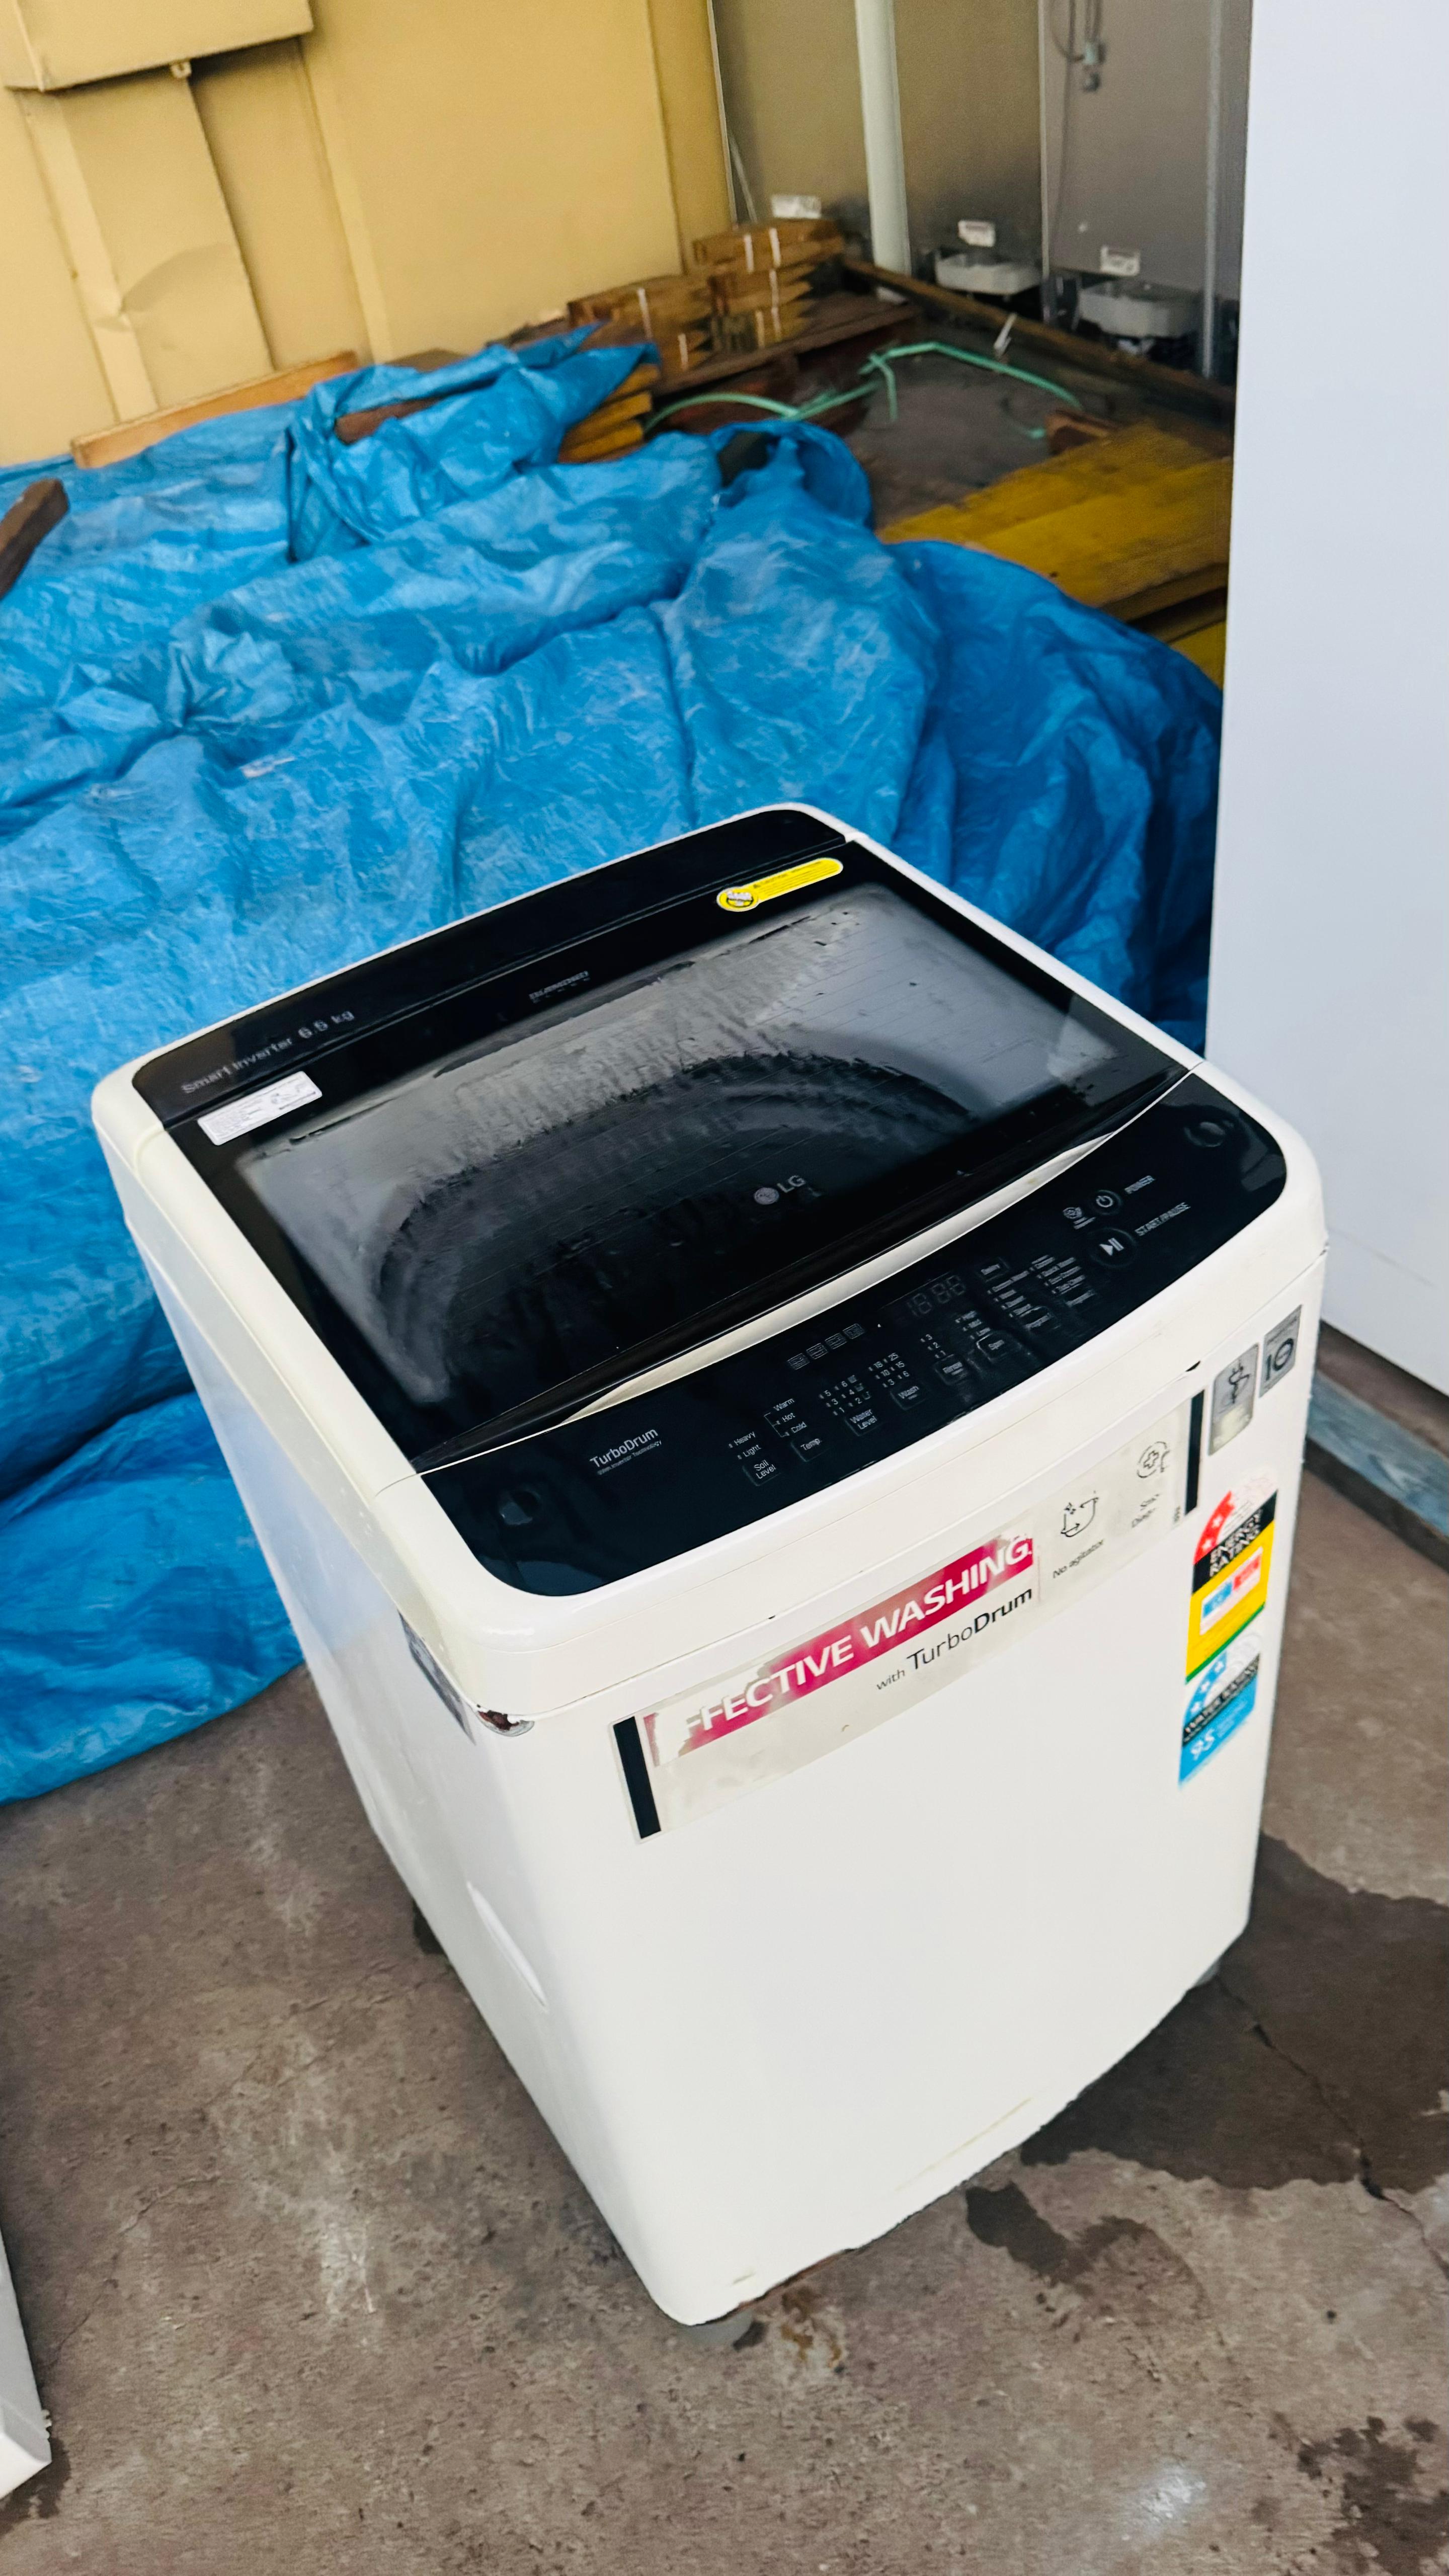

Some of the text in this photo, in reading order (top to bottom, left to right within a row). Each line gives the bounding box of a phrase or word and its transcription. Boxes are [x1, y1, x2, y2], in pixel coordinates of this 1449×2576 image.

[181, 1065, 231, 1093] Smart
[331, 1011, 355, 1024] kg
[776, 1175, 806, 1193] LG
[888, 1352, 899, 1361] 25
[1265, 1338, 1295, 1382] 10
[880, 1369, 891, 1377] 10
[898, 1386, 920, 1399] Wash
[773, 1398, 795, 1411] Warm
[782, 1412, 796, 1423] Hot
[849, 1409, 873, 1424] Water
[857, 1416, 878, 1430] Level
[790, 1421, 808, 1433] Cold
[733, 1431, 756, 1446] Heavy
[590, 1429, 659, 1468] TurboDrum
[742, 1444, 762, 1458] Light
[754, 1459, 769, 1471] Soil
[755, 1464, 776, 1479] Level
[1053, 1540, 1103, 1579] No agitator
[876, 1588, 1032, 1690] with TurboDrum
[686, 1635, 854, 1731] FECTIVE
